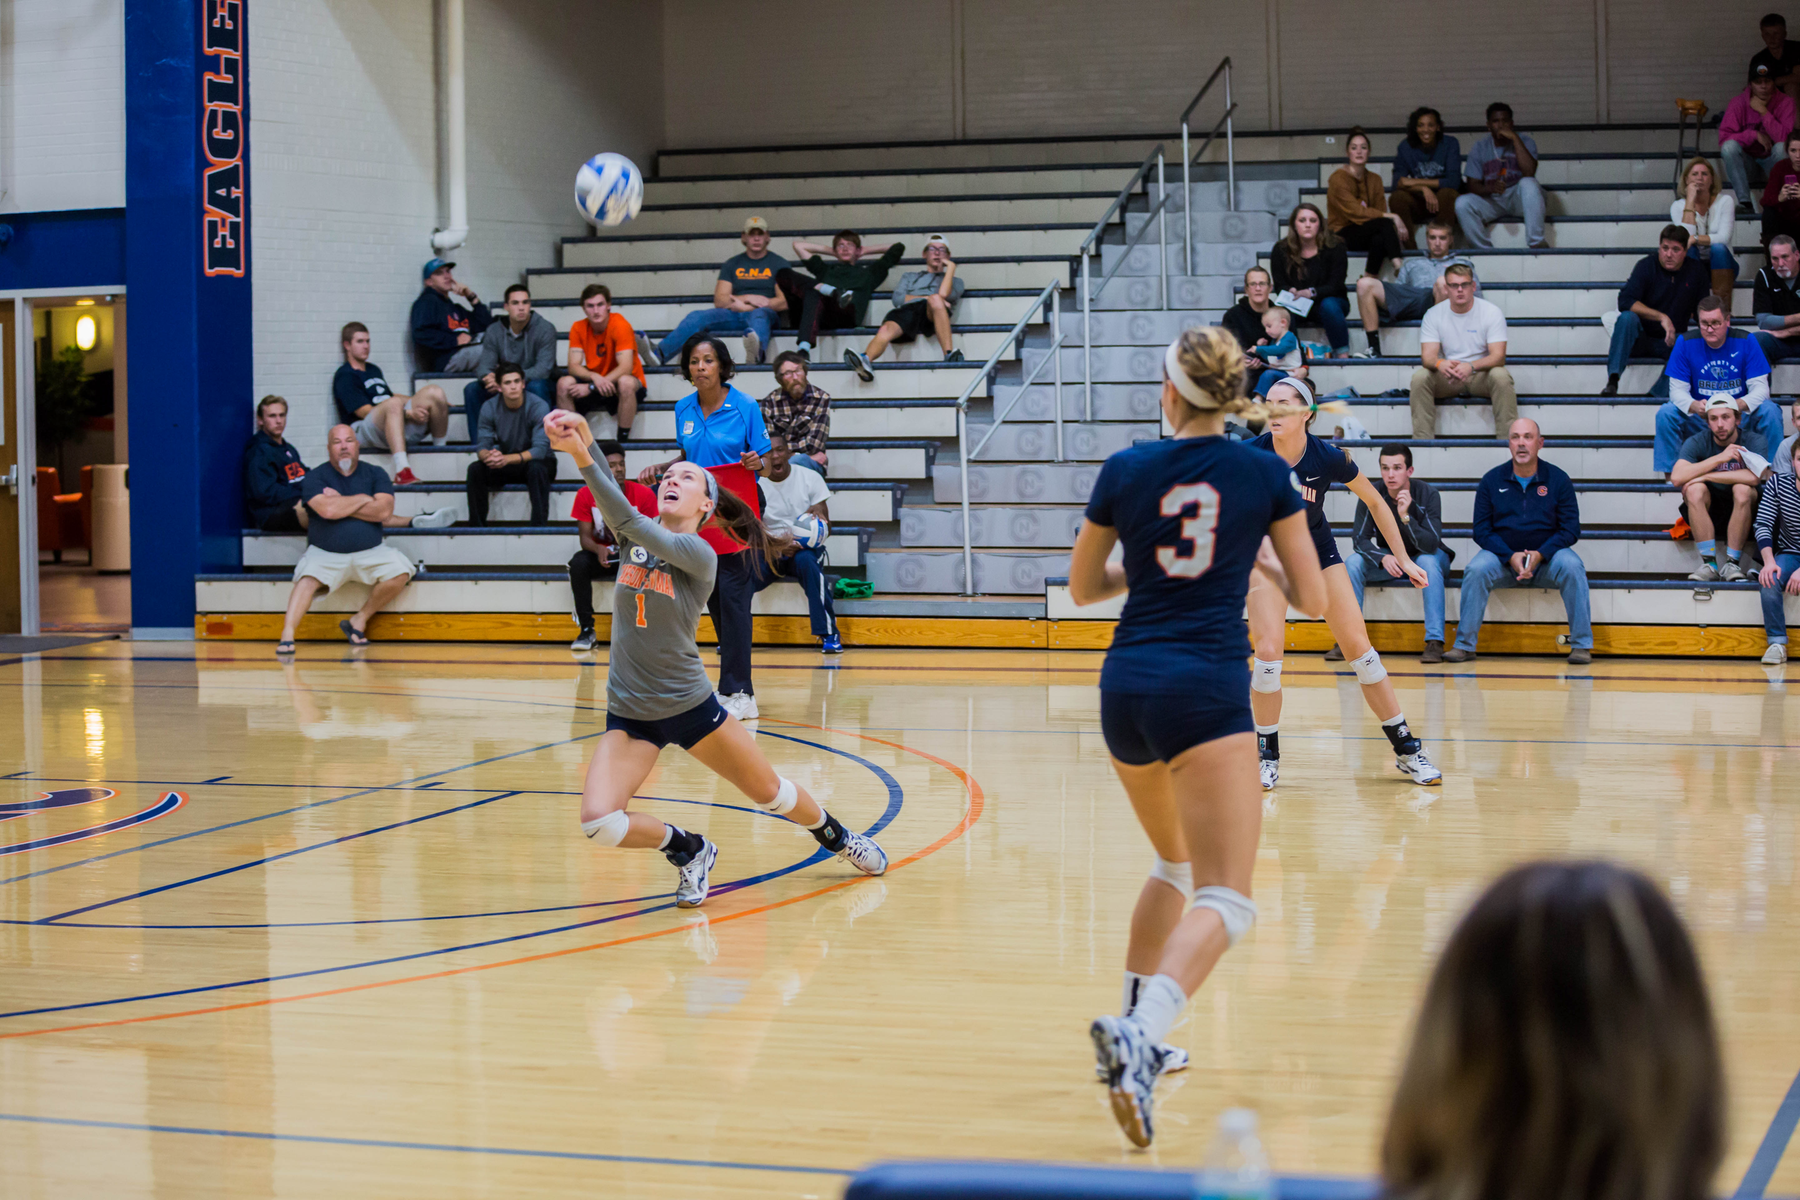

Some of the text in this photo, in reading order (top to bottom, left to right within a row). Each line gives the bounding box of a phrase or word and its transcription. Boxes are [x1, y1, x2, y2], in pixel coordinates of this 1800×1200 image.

[1698, 378, 1742, 390] BREVARD
[1155, 481, 1221, 579] 3
[635, 593, 647, 628] 1
